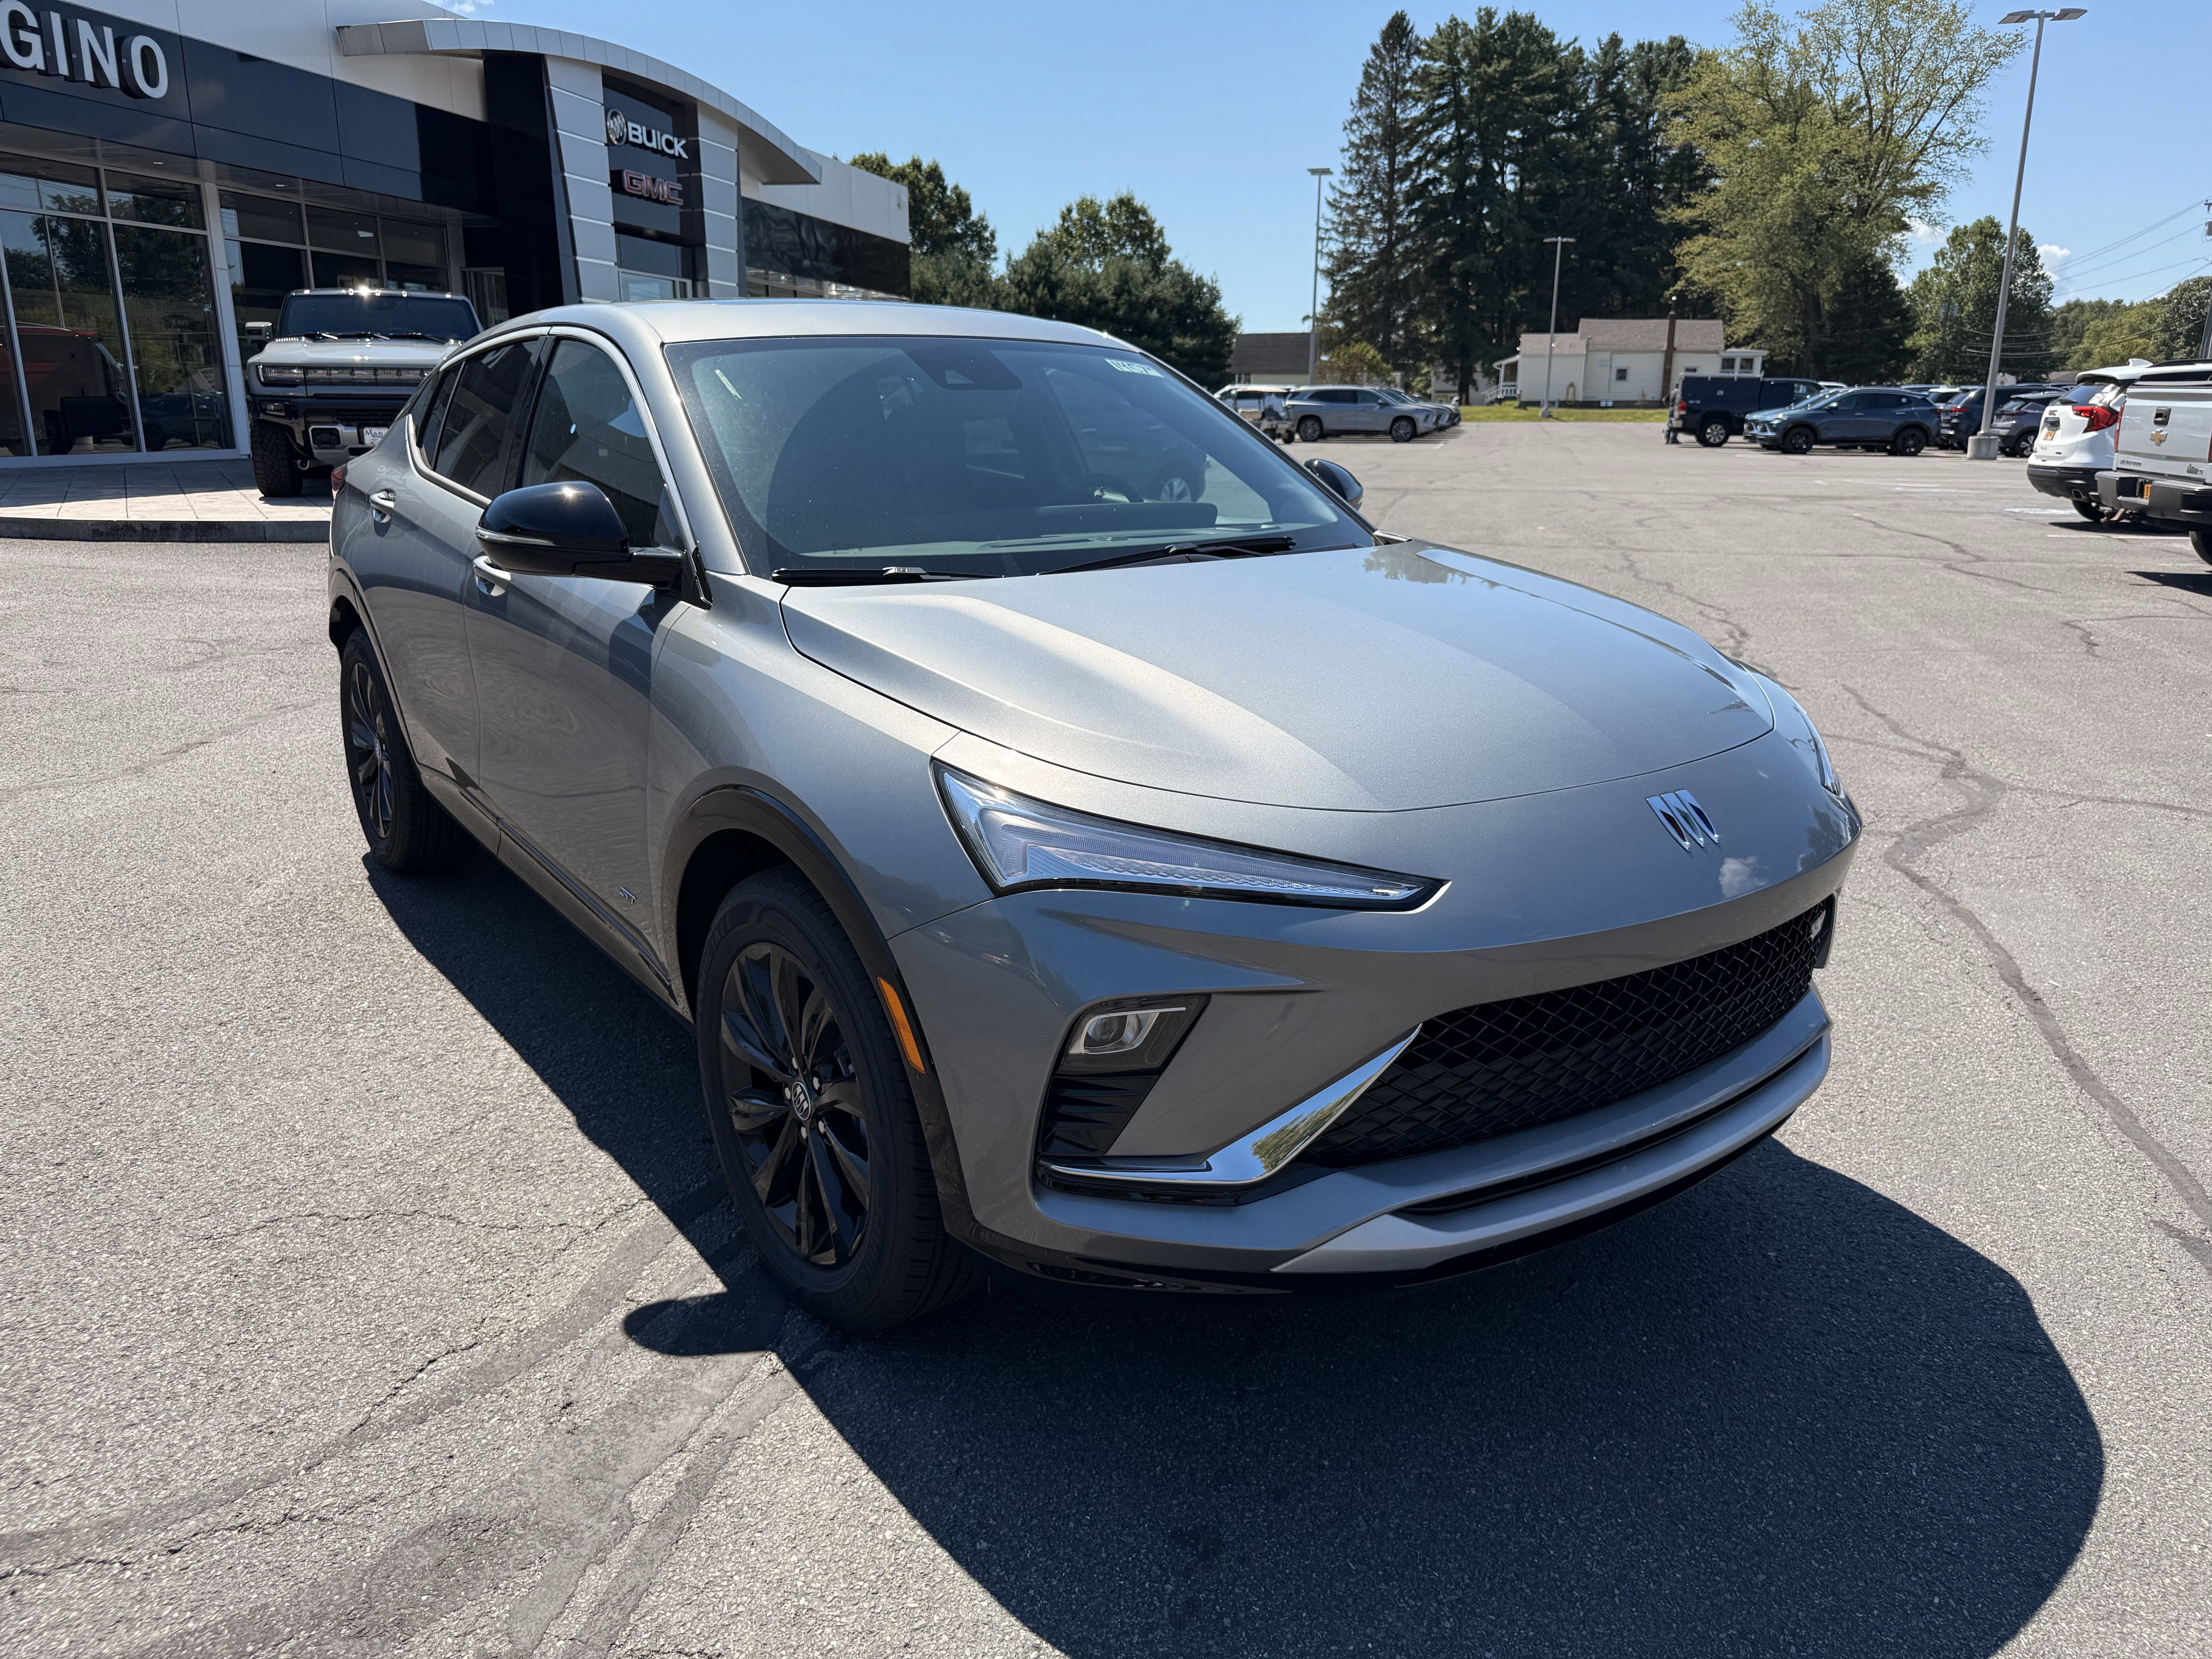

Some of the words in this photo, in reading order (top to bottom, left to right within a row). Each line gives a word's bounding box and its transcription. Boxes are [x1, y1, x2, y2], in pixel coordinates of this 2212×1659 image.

[0, 0, 168, 98] GINO
[627, 121, 689, 159] BUICK
[623, 169, 684, 205] GMC
